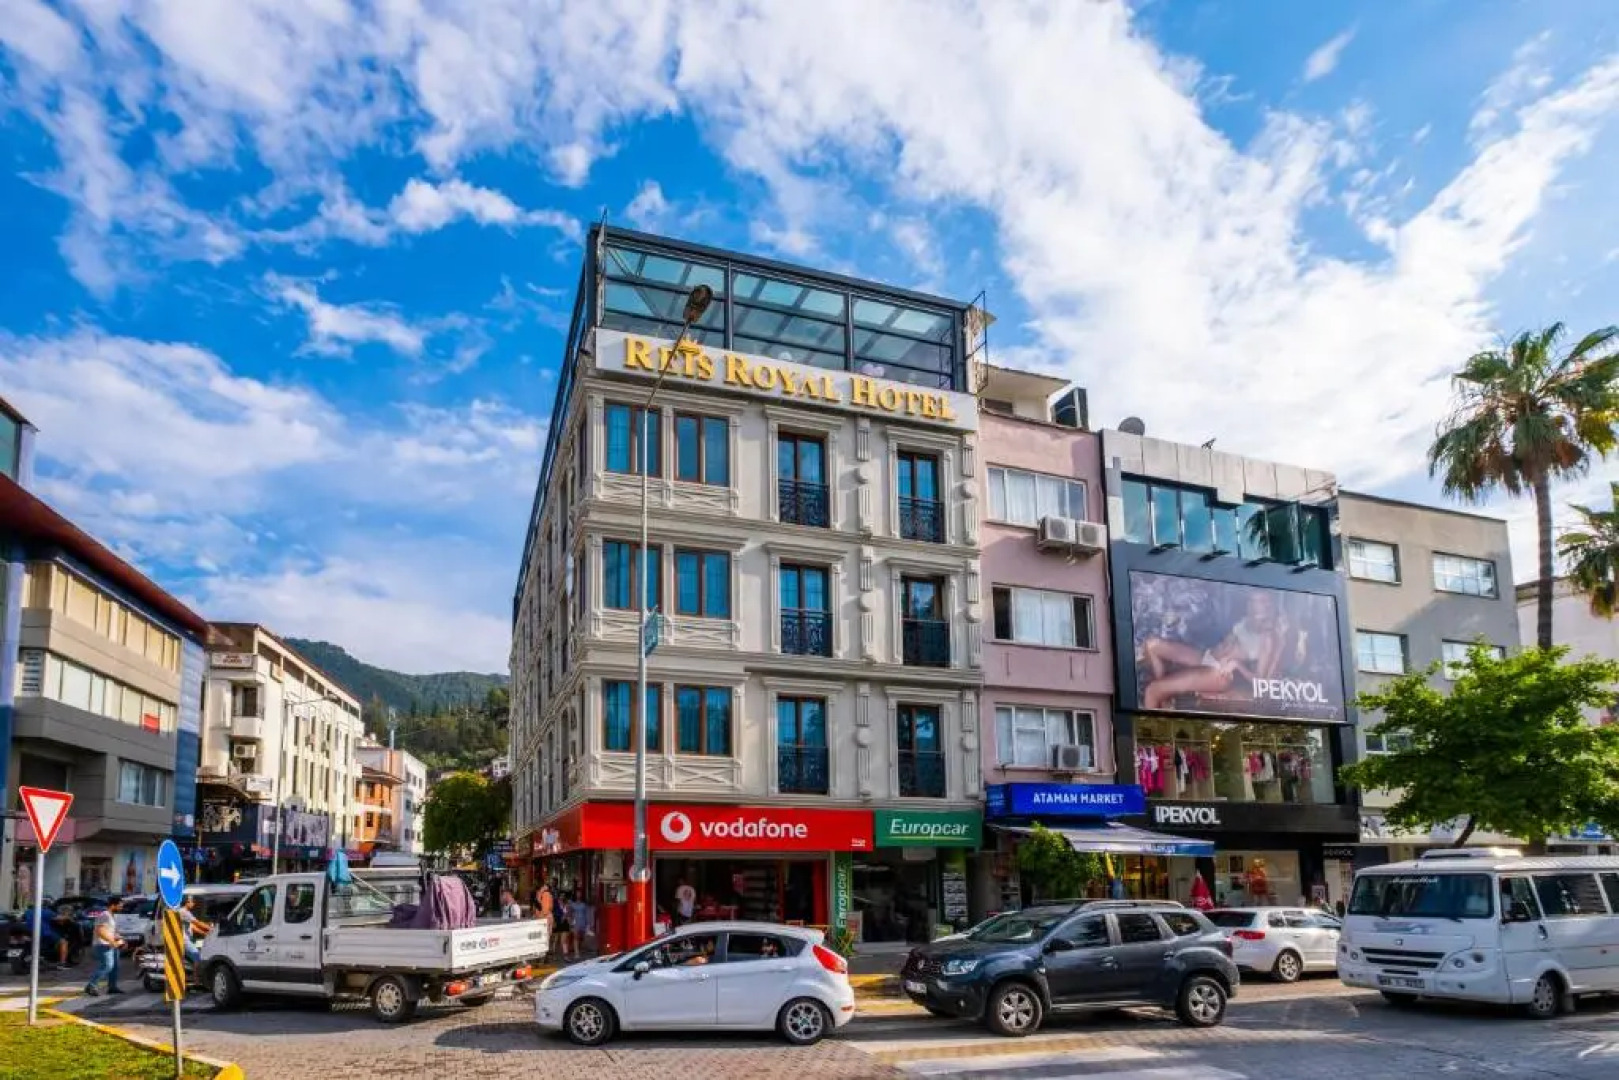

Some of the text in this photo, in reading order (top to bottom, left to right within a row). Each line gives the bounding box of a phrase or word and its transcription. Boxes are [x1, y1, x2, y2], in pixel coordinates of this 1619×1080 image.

[724, 353, 841, 402] ROYAL
[850, 375, 957, 421] HOTEL
[1253, 677, 1329, 703] IPEKYOL
[1033, 792, 1124, 804] ATAMAN MARKET
[1155, 805, 1221, 824] IPEKYOL
[699, 819, 808, 839] vodafone
[889, 818, 969, 837] Europcar
[836, 862, 849, 928] Europcar
